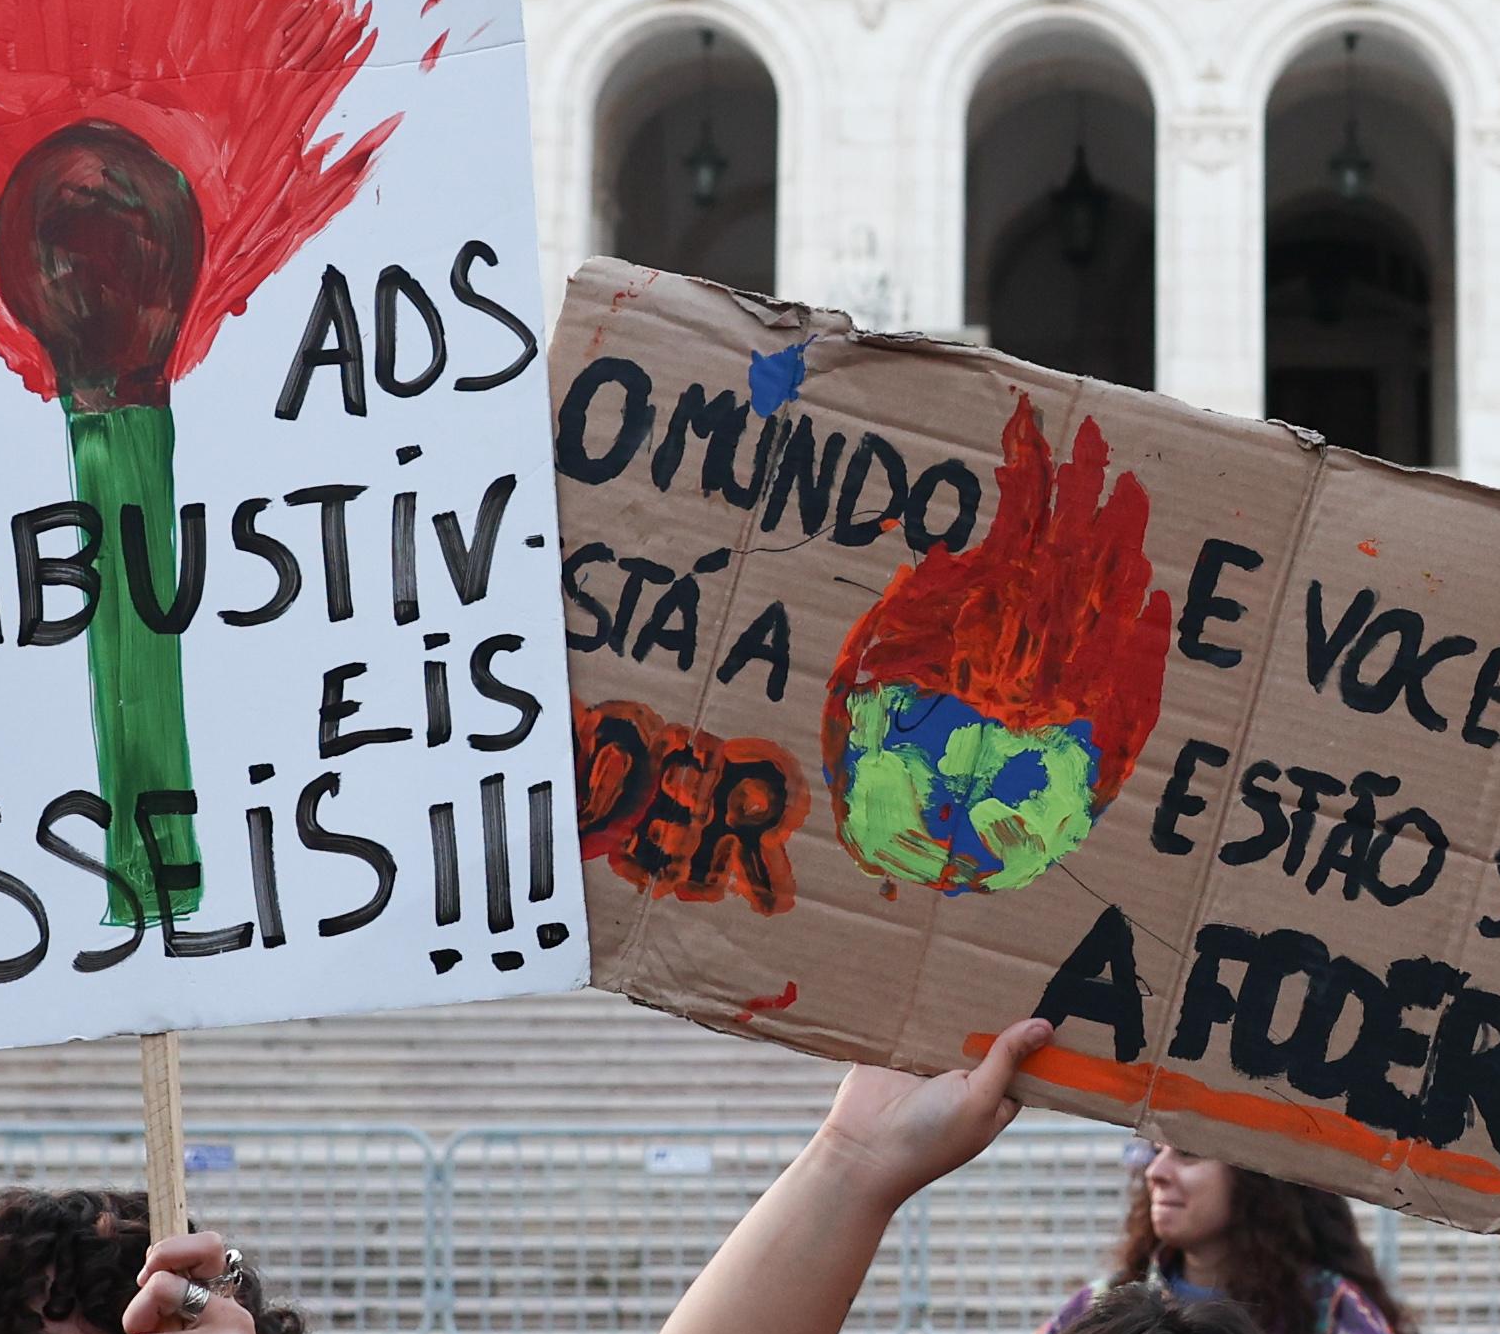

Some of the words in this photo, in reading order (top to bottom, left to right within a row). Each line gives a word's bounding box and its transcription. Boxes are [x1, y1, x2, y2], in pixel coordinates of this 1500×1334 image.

[556, 356, 656, 486] O
[651, 383, 983, 555] MUNDO
[558, 541, 732, 672] STÁ
[716, 600, 791, 703] A
[1177, 538, 1264, 668] E
[573, 709, 798, 905] DER
[1150, 738, 1450, 906] ESTÃO
[1030, 904, 1148, 1063] A
